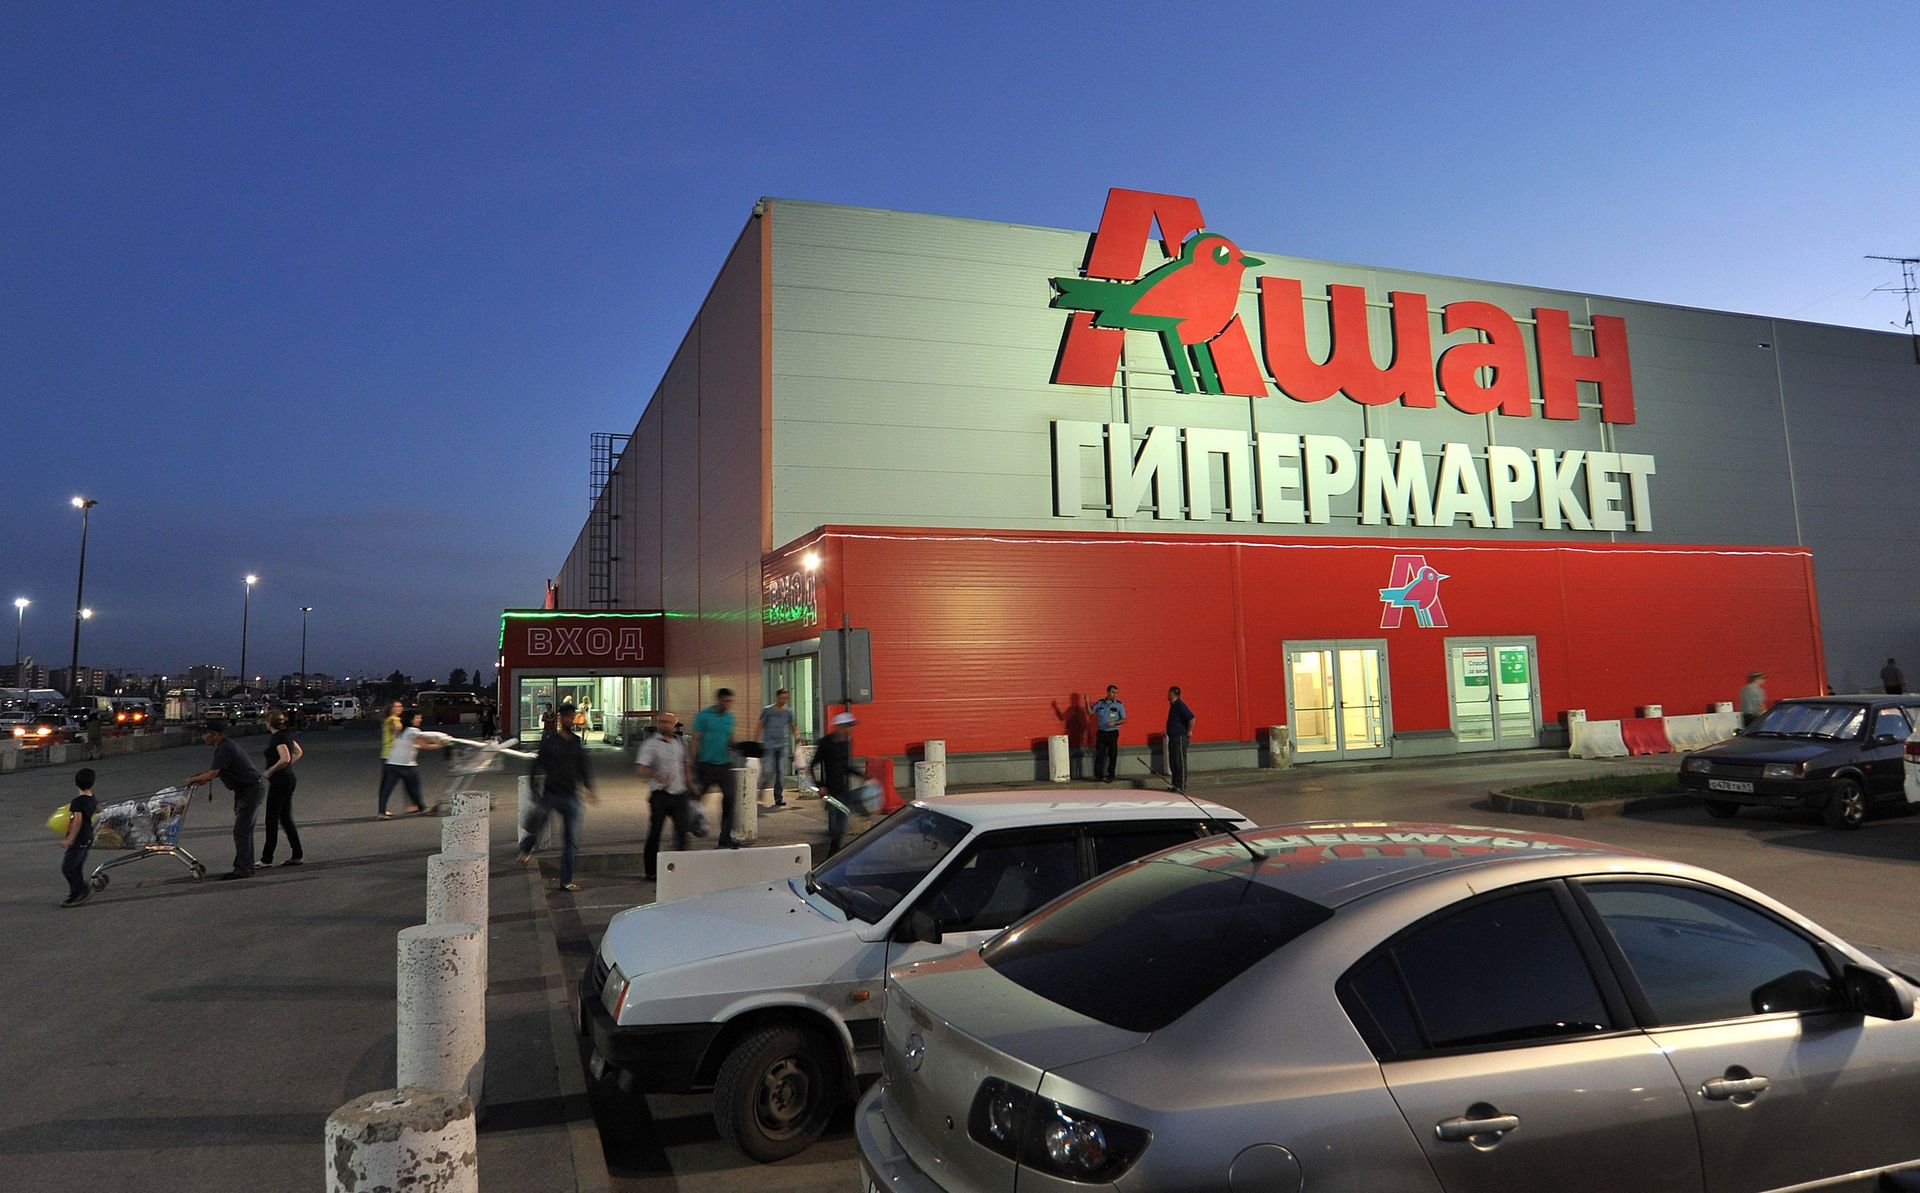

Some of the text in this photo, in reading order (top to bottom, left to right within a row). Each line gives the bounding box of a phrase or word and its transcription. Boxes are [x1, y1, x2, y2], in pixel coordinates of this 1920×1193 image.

[1050, 187, 1636, 425] Ашан
[1053, 420, 1656, 533] ГИПЕРМАРКЕТ
[769, 571, 818, 627] ВХОД
[527, 627, 644, 660] ВХОД
